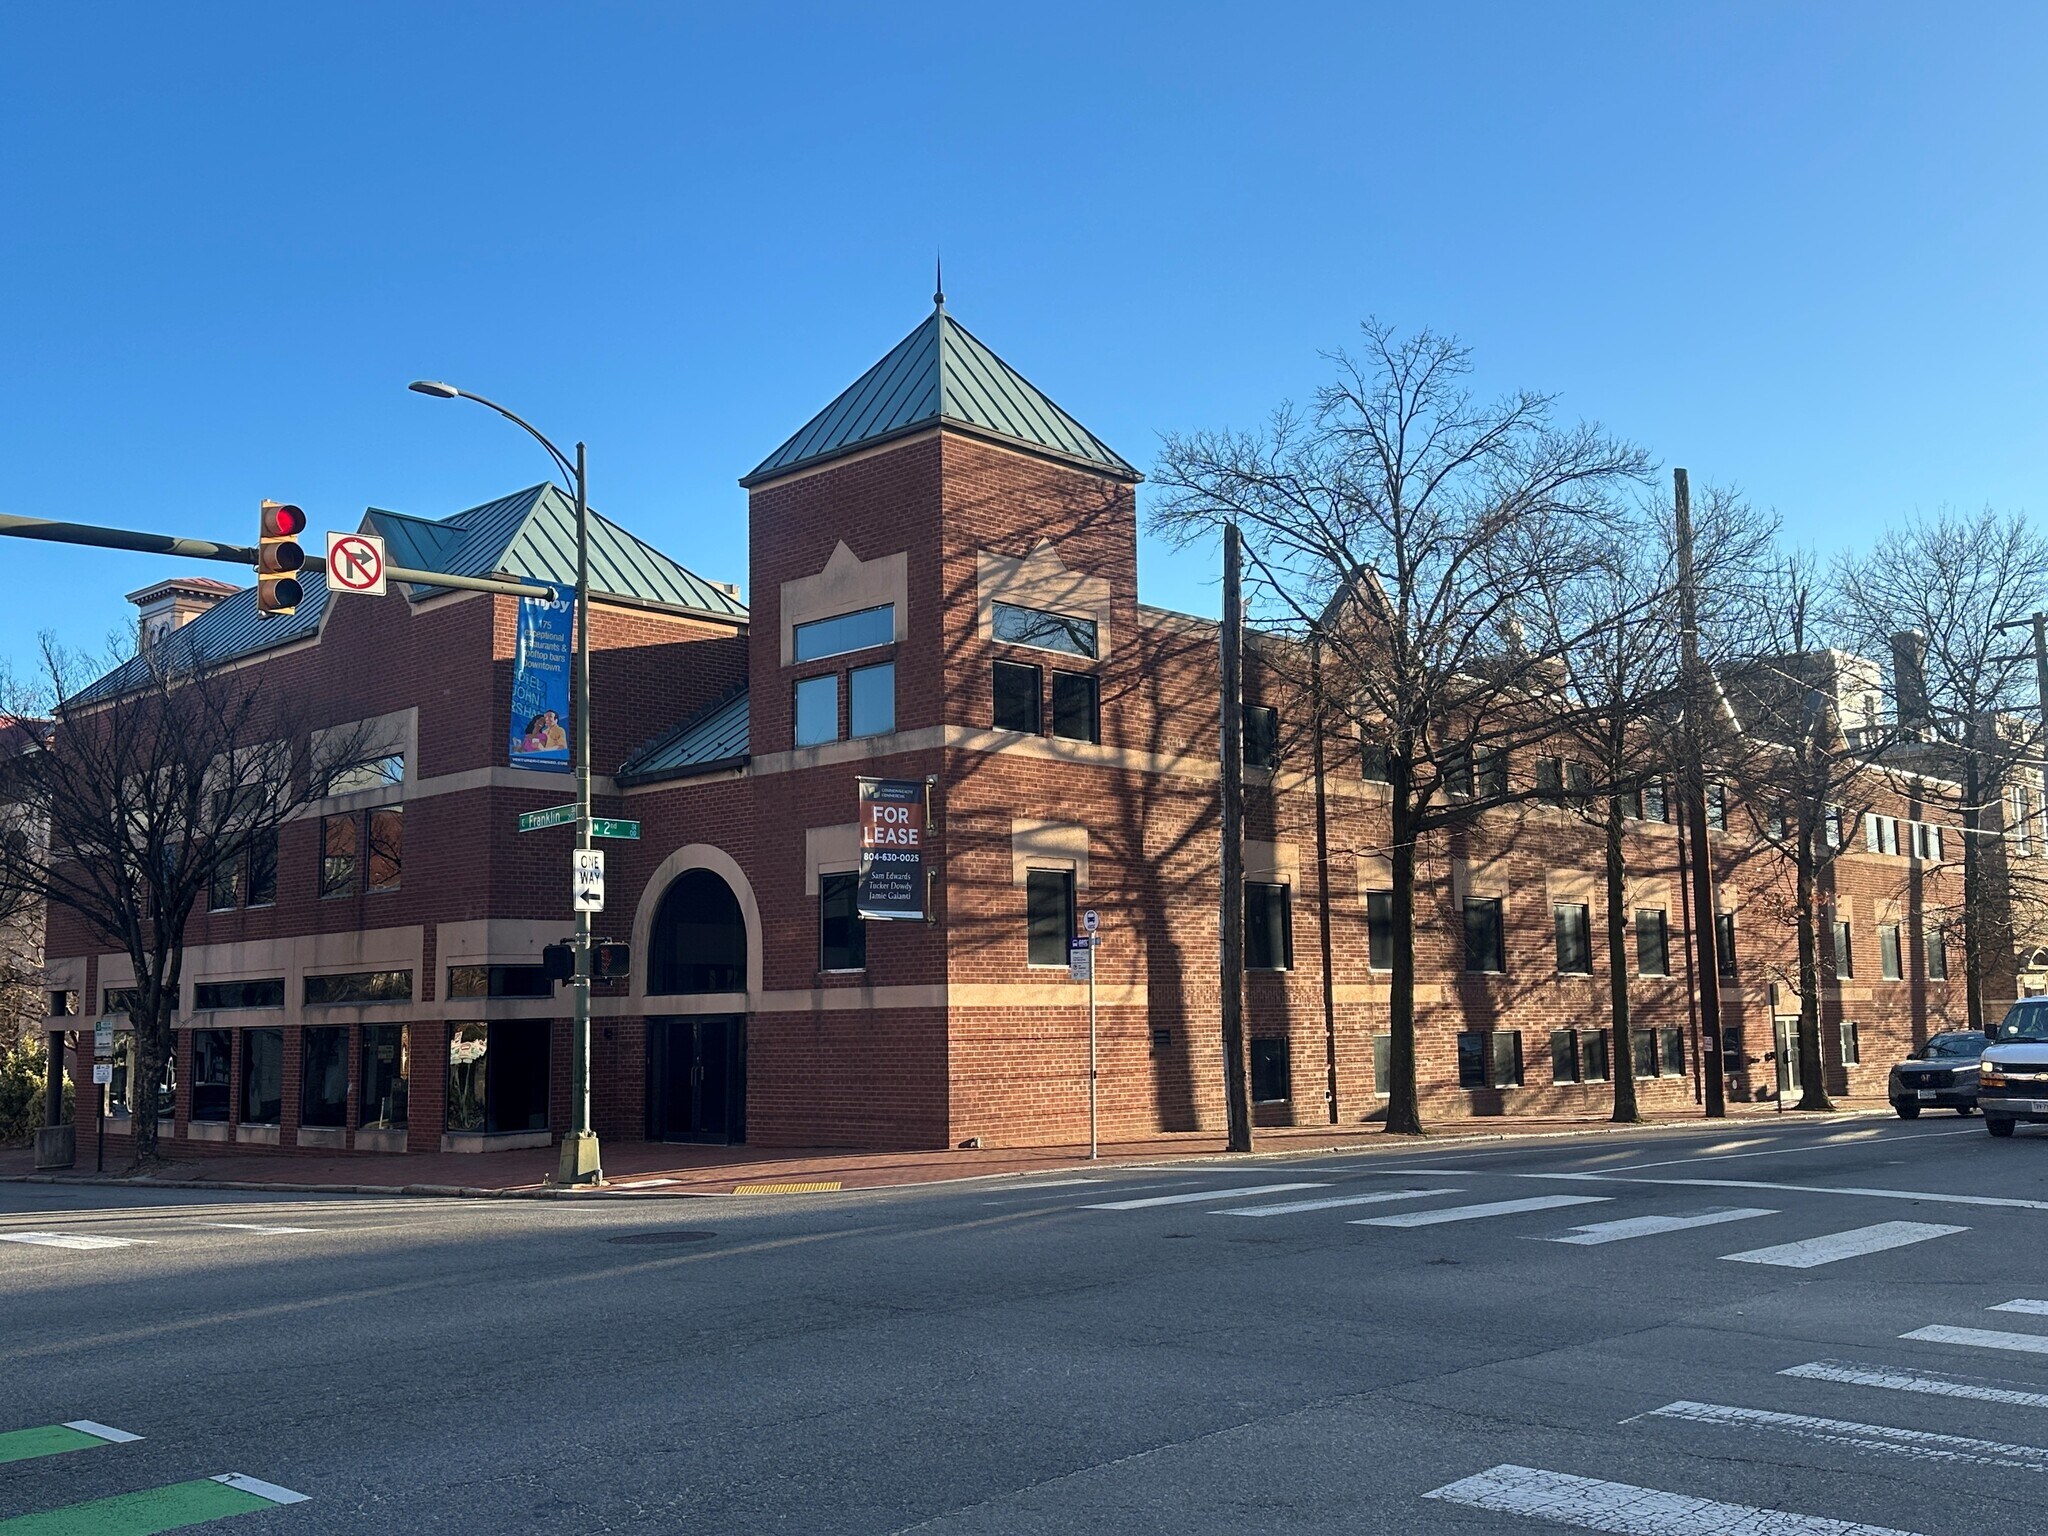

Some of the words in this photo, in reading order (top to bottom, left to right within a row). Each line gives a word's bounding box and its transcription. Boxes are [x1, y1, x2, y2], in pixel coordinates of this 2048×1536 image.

[539, 619, 552, 629] 175
[561, 644, 567, 653] &
[523, 648, 549, 661] ooftop
[549, 651, 566, 663] bars
[512, 684, 540, 706] JOHN
[521, 818, 526, 828] E
[529, 811, 561, 828] Franklin
[873, 805, 909, 824] FOR
[593, 823, 600, 832] N
[603, 821, 618, 835] 2nd
[863, 826, 919, 845] LEASE
[580, 855, 600, 870] ONE
[863, 852, 920, 863] 804-630-0025
[579, 871, 601, 884] WAY
[871, 871, 885, 880] Sam
[886, 871, 911, 881] Edwards
[869, 881, 890, 890] Tucker
[890, 881, 912, 892] Dowdy
[869, 891, 887, 901] Jamie
[887, 891, 911, 900] Galanti
